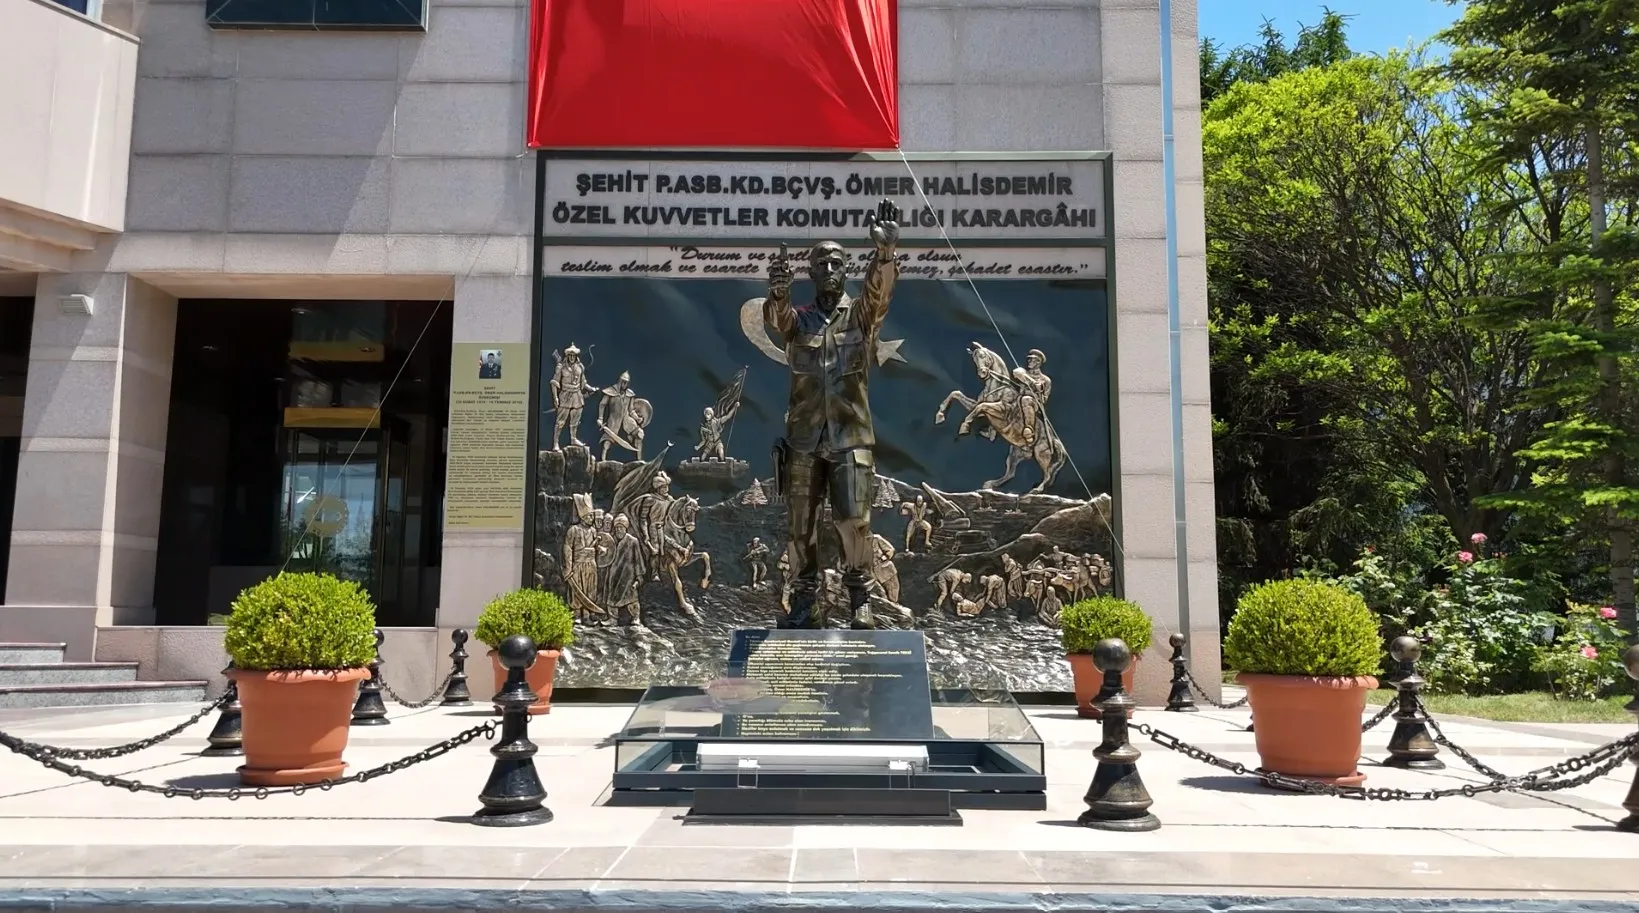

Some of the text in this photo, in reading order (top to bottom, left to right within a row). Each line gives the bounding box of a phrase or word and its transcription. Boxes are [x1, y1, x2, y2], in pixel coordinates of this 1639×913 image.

[576, 169, 649, 196] ŞEHİT
[923, 172, 1073, 196] HALİSDEMİR
[552, 201, 1096, 228] ÖZEL KUVVETLER KOMUTALIĞI KARARGÂHI
[747, 250, 765, 261] ve
[560, 259, 613, 273] teslim
[618, 260, 673, 274] olmak
[678, 263, 697, 274] ve
[702, 260, 760, 274] esarete
